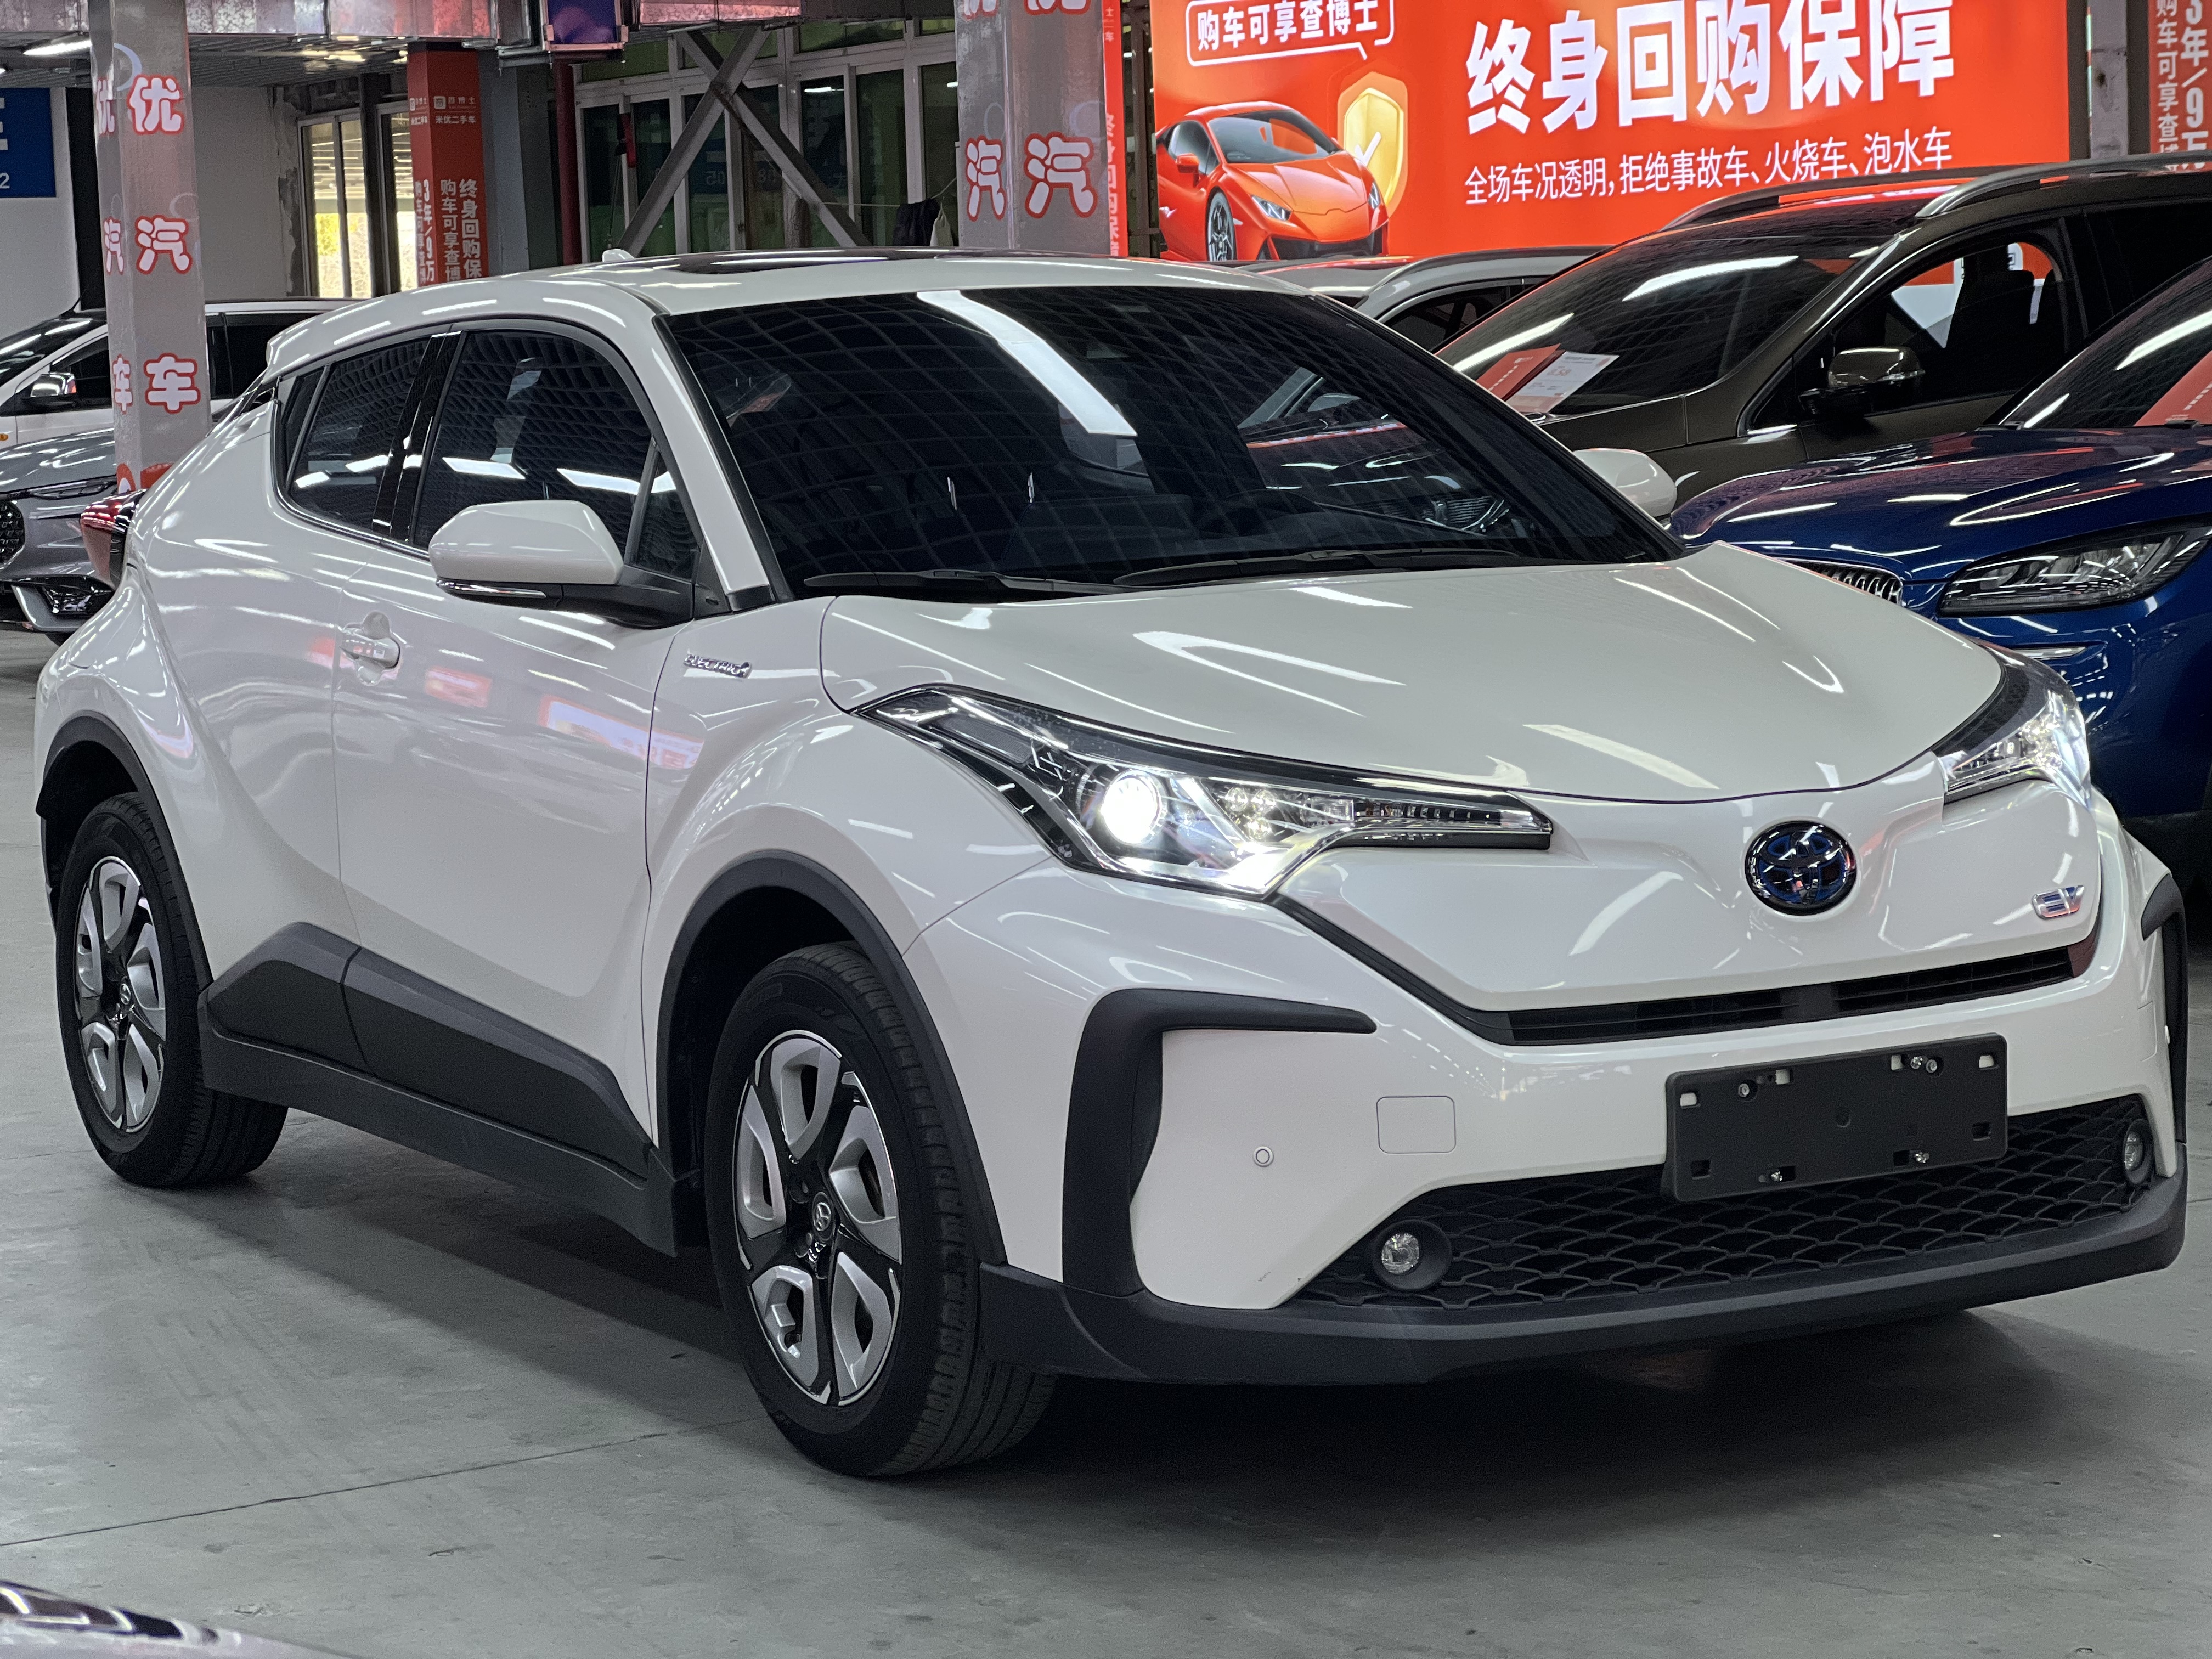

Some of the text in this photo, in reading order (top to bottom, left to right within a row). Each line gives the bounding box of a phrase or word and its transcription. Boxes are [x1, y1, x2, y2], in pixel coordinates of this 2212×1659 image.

[1197, 0, 1379, 52] 购车可享查博士
[1465, 0, 1955, 135] 终身回购保障
[459, 179, 482, 278] 终身回购保
